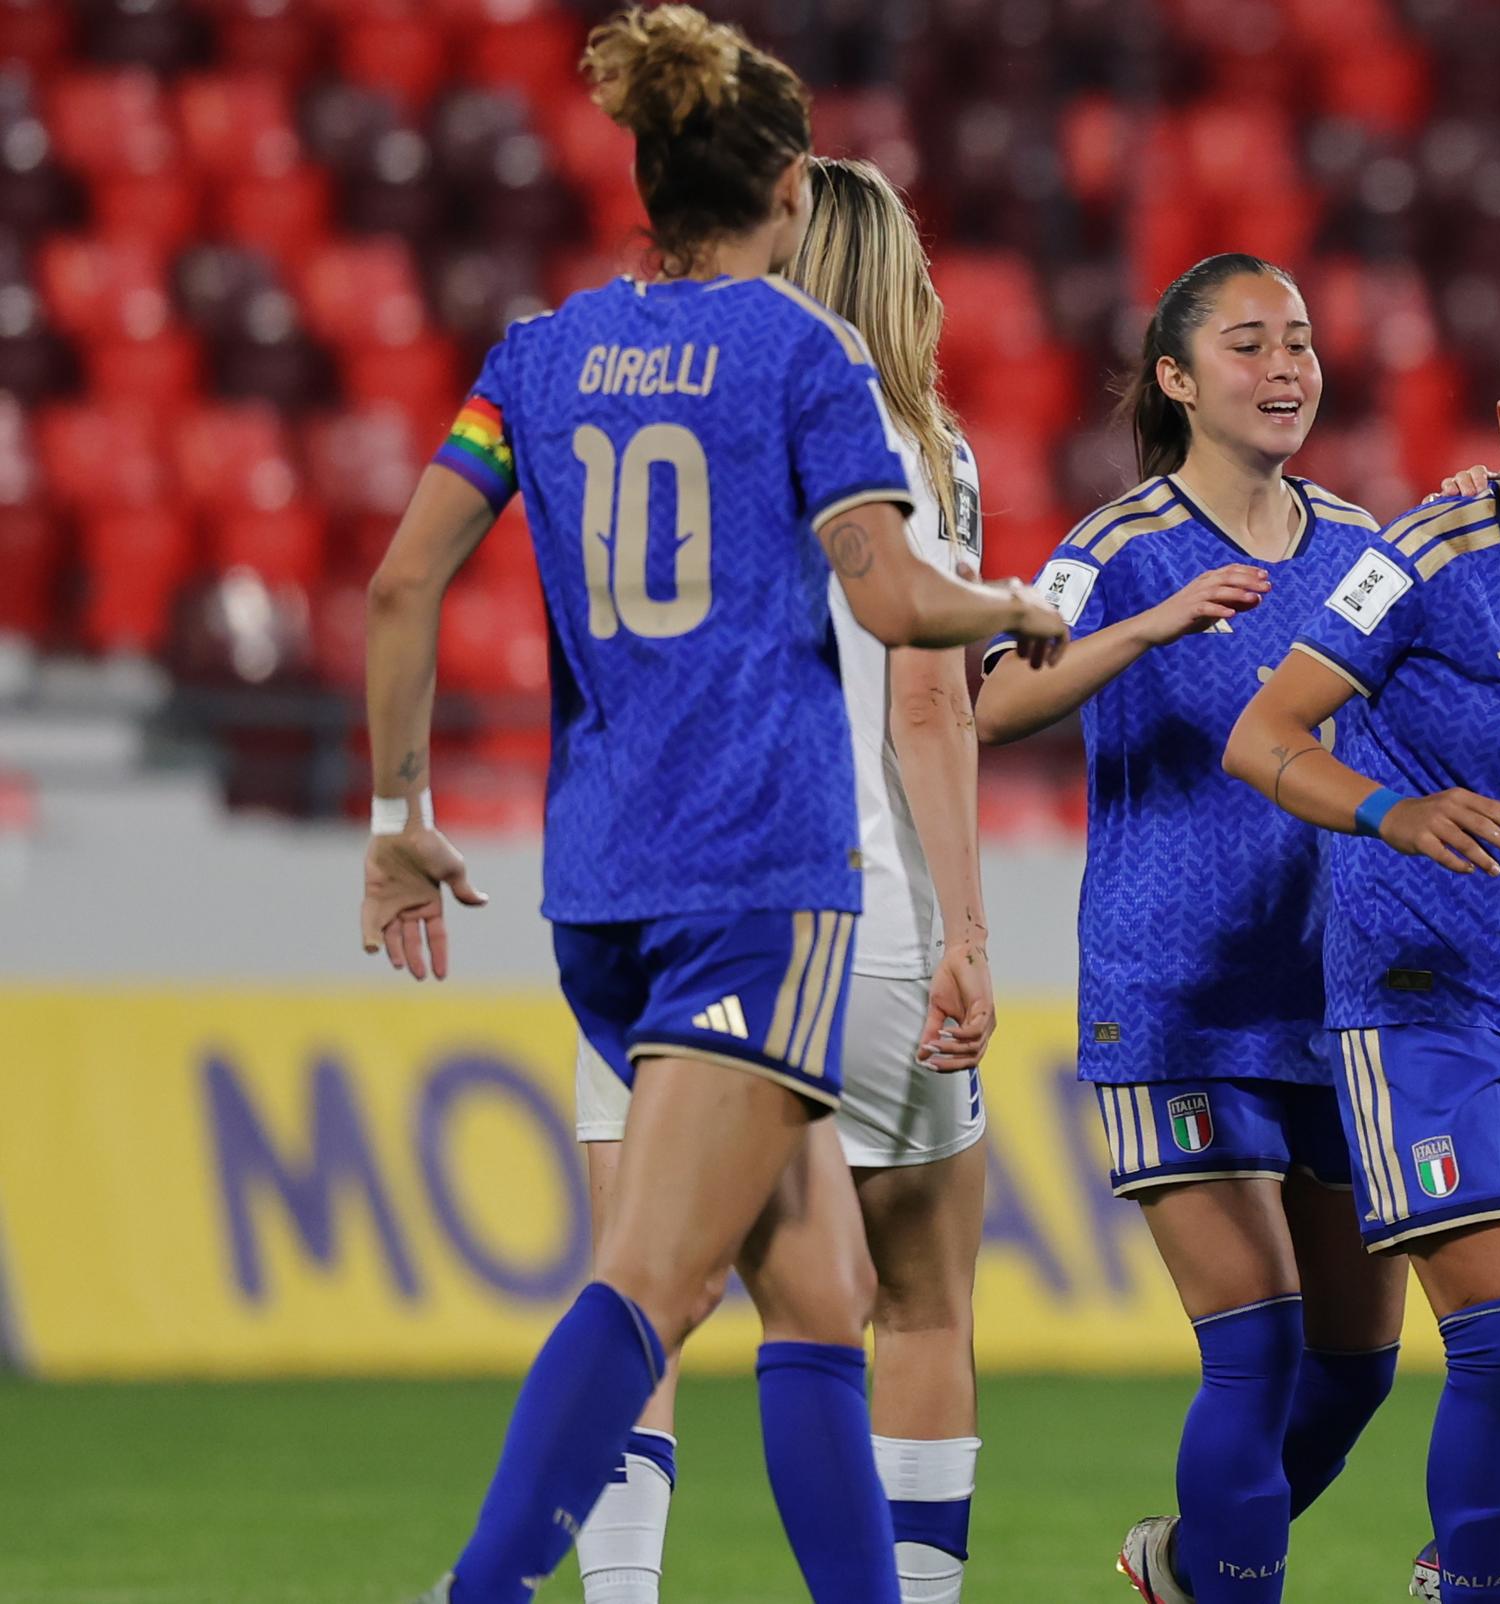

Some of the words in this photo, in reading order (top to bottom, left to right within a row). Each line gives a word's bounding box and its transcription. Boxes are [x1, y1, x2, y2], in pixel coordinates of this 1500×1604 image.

[578, 343, 720, 397] GIRELLI
[572, 423, 712, 641] 10
[1170, 1097, 1206, 1115] ITALIA
[1415, 1140, 1450, 1159] ITALIA
